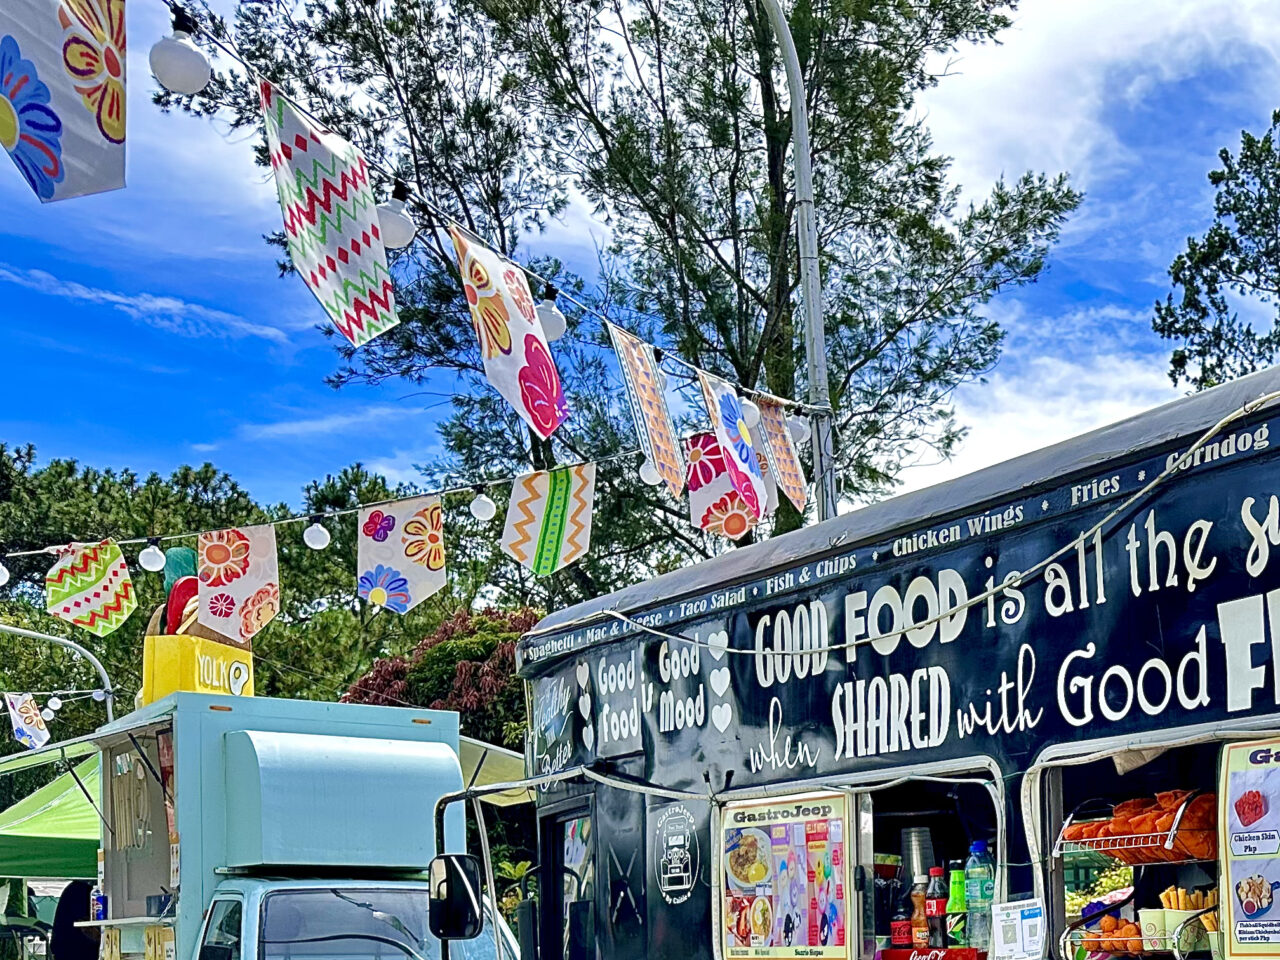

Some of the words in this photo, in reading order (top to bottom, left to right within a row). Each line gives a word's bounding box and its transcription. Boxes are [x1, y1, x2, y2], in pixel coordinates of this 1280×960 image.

[528, 634, 575, 661] Spaghetti
[586, 625, 607, 645] Mac
[609, 621, 620, 637] &
[679, 596, 707, 617] Taco
[709, 586, 746, 612] Salad
[766, 576, 793, 596] Fish
[798, 569, 811, 587] &
[815, 553, 857, 582] Chips
[892, 525, 963, 558] Chicken
[965, 503, 1025, 538] Wings
[1071, 472, 1121, 507] Fries
[1165, 424, 1270, 471] Corndog
[754, 598, 828, 689] GOOD
[844, 570, 970, 664] FOOD
[985, 556, 1025, 628] is
[1043, 528, 1107, 618] all
[1125, 510, 1218, 598] the
[196, 655, 228, 688] YOLK
[598, 650, 636, 696] Good
[640, 671, 655, 714] is
[658, 633, 700, 684] Good
[749, 698, 822, 775] when
[832, 666, 951, 762] SHARED
[956, 641, 1045, 739] with
[1056, 623, 1211, 727] Good
[602, 697, 638, 743] Food
[659, 683, 705, 733] Mood
[732, 804, 833, 824] GastroJeep
[1234, 834, 1261, 842] Chicken
[1261, 832, 1276, 841] Skin
[1244, 844, 1258, 854] Php
